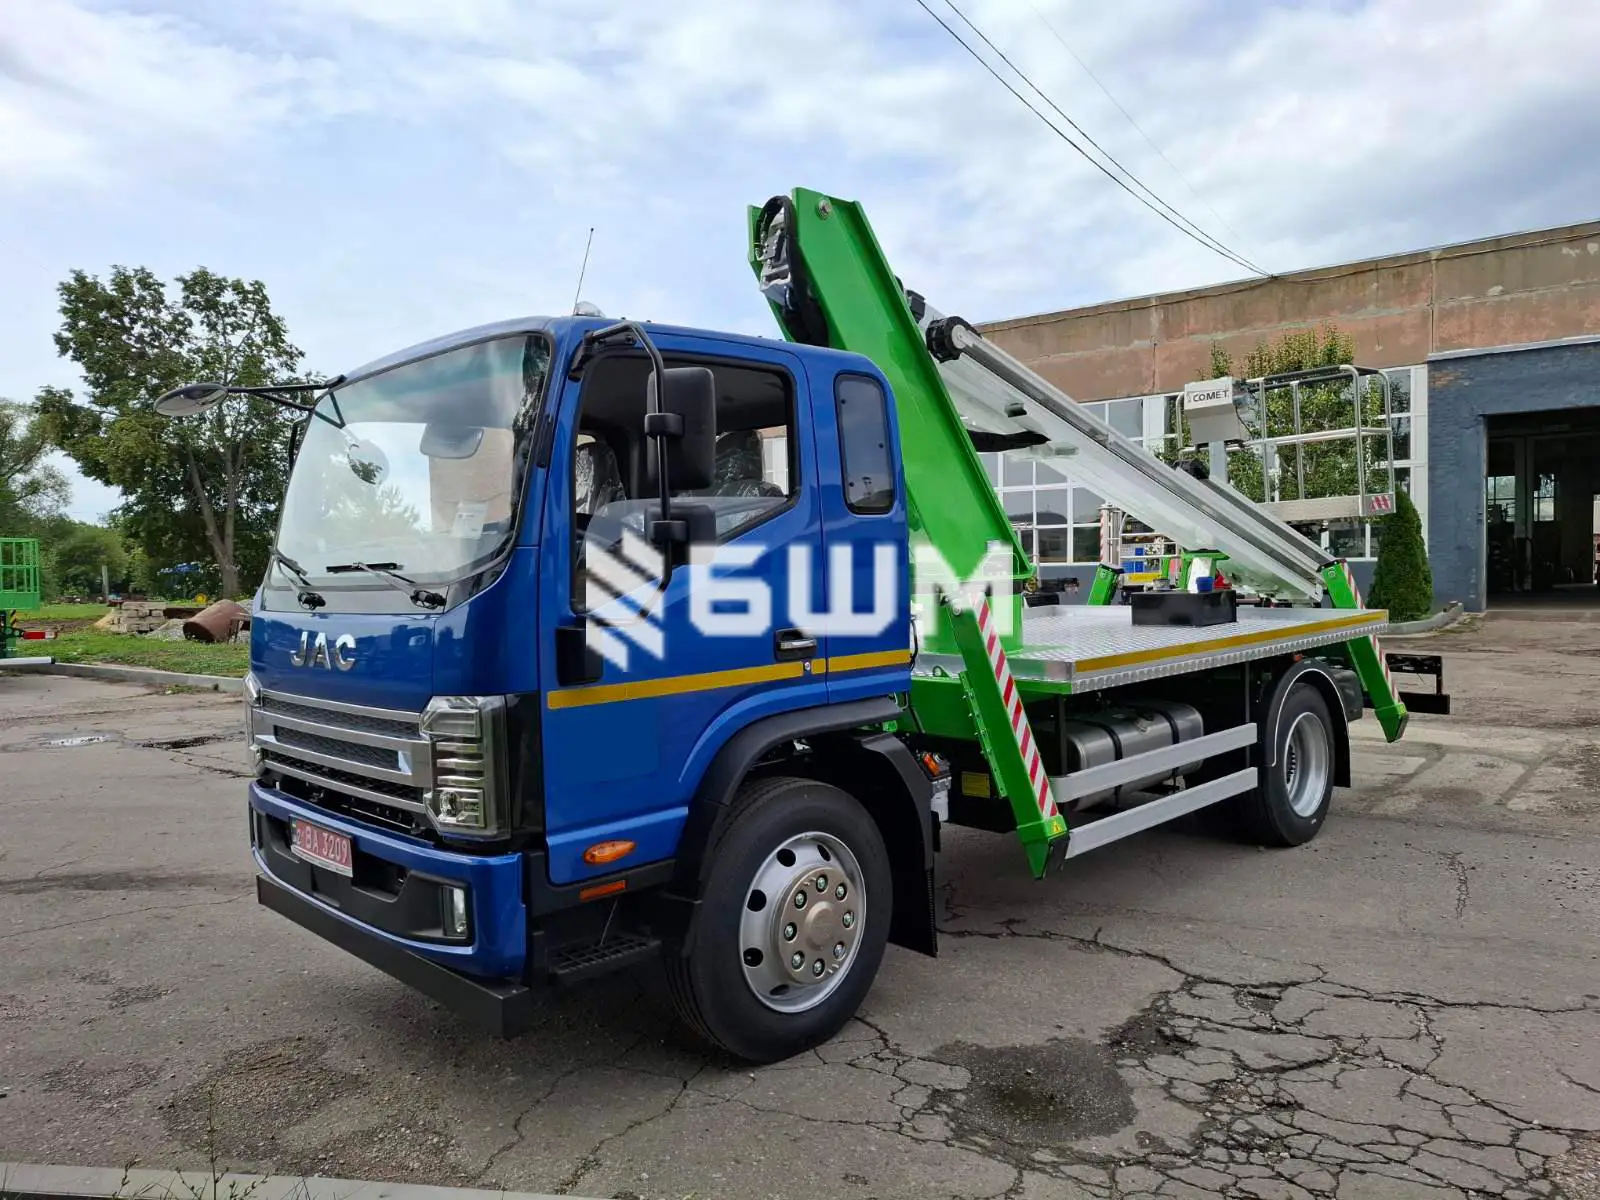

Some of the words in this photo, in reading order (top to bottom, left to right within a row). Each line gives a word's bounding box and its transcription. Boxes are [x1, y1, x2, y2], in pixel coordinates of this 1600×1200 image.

[1192, 390, 1229, 402] COMET
[289, 630, 357, 672] JAC
[322, 831, 349, 865] 3209
